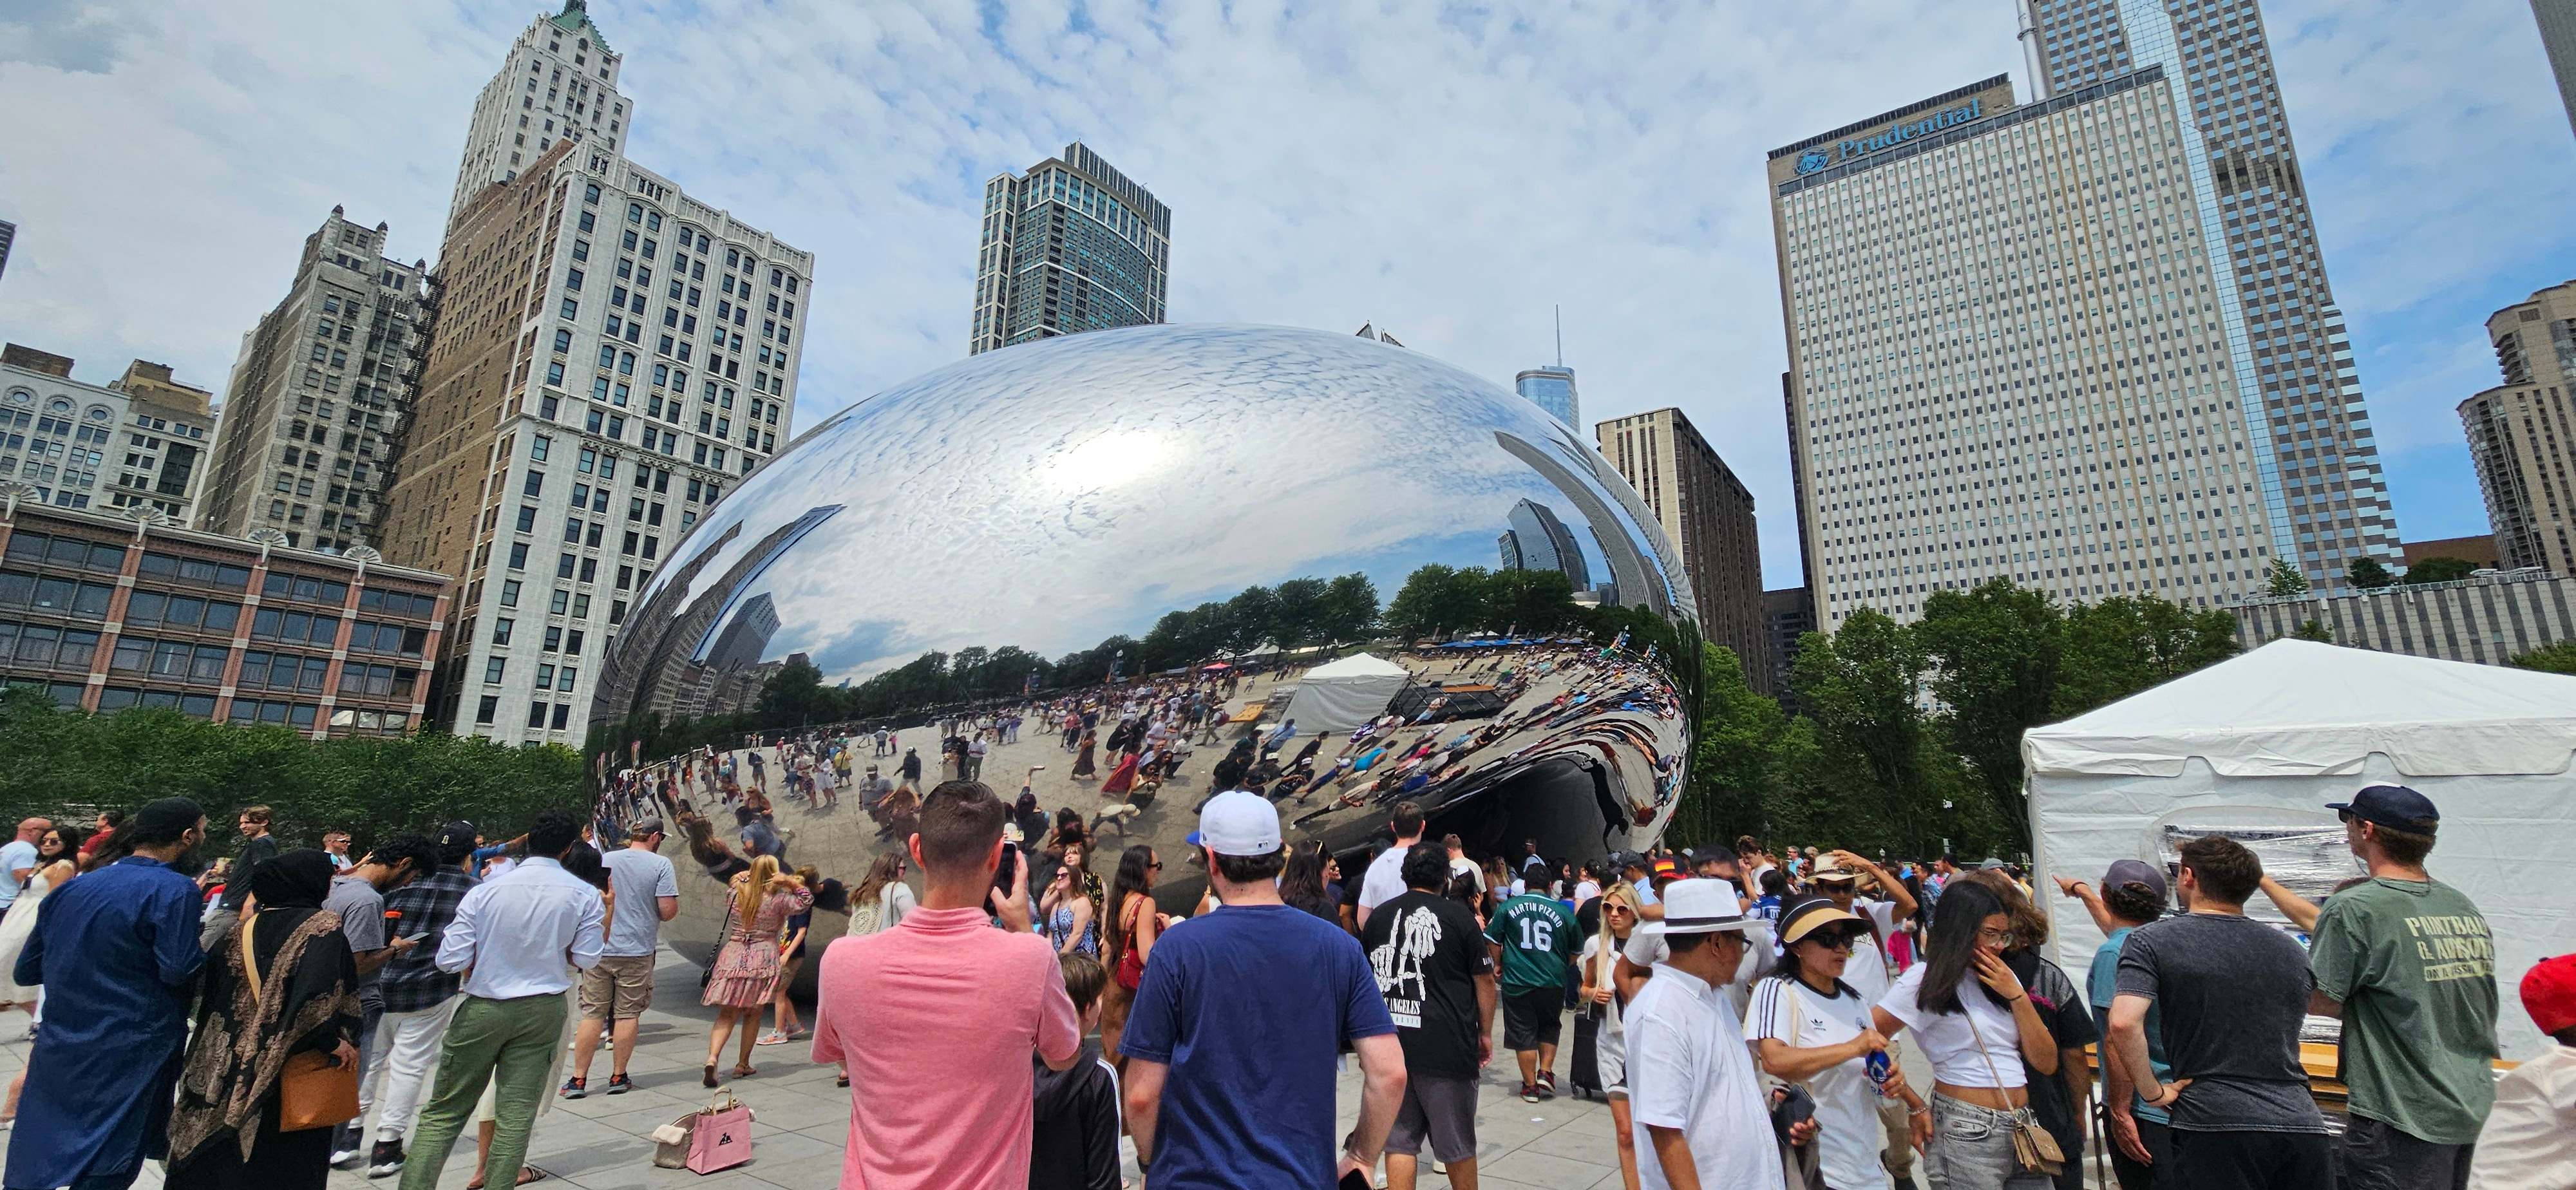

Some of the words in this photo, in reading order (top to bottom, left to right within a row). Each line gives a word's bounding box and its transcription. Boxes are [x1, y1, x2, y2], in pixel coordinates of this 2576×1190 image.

[1838, 98, 1982, 160] Prudential
[1508, 902, 1537, 919] MARTIN
[1539, 903, 1563, 928] PIZANO
[1520, 917, 1553, 952] 16
[2416, 940, 2435, 960] &
[1390, 997, 1421, 1015] ANGELES
